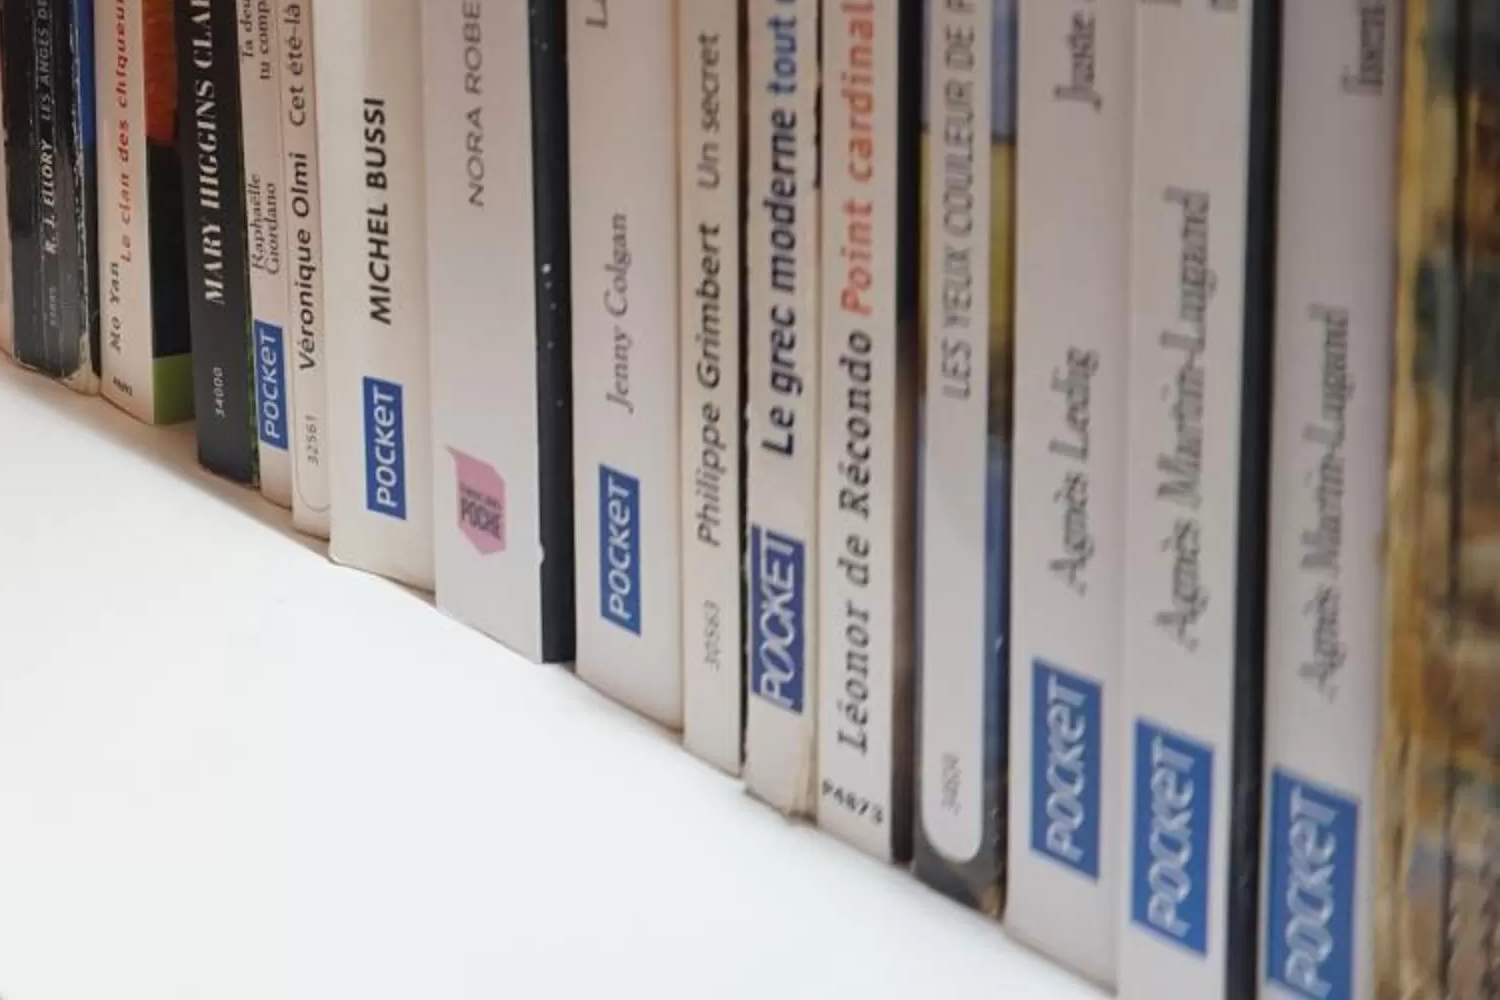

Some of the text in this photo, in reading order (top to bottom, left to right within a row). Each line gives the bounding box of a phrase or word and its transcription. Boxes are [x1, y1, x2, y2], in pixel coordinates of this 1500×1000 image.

[37, 26, 49, 87] ANGES
[259, 58, 271, 81] tu
[284, 4, 306, 127] Cet été-là
[765, 15, 798, 95] tout
[943, 27, 974, 69] DE
[1052, 9, 1103, 113] Juste
[118, 119, 129, 163] des
[195, 77, 220, 208] HIGGINS
[467, 106, 484, 210] NORA
[698, 32, 721, 190] Un secret
[839, 0, 875, 317] Point cardinal
[942, 81, 975, 236] COULEUR
[40, 137, 54, 206] ELLORY
[119, 173, 130, 225] clan
[250, 174, 268, 272] Raphaëlle
[363, 98, 392, 325] MICHEL BUSSI
[761, 109, 798, 294] moderne
[120, 234, 131, 263] Le
[200, 220, 224, 303] MARY
[265, 182, 281, 276] Giordano
[289, 152, 317, 371] Véronique Olmi
[109, 261, 121, 354] Mo Yan
[603, 212, 634, 414] Jenny Colgan
[941, 245, 974, 329] YEUX
[695, 222, 728, 547] Philippe Grimbert
[767, 306, 802, 396] grec
[941, 341, 973, 400] LES
[760, 406, 795, 459] Le
[1154, 186, 1217, 650] Agnès Martin-Lugand
[1047, 345, 1101, 599] Agnès Ledig
[1297, 303, 1355, 703] Agnès Martin-Lugand
[836, 329, 872, 756] Léonor de Récondo
[759, 529, 795, 708] POCKET
